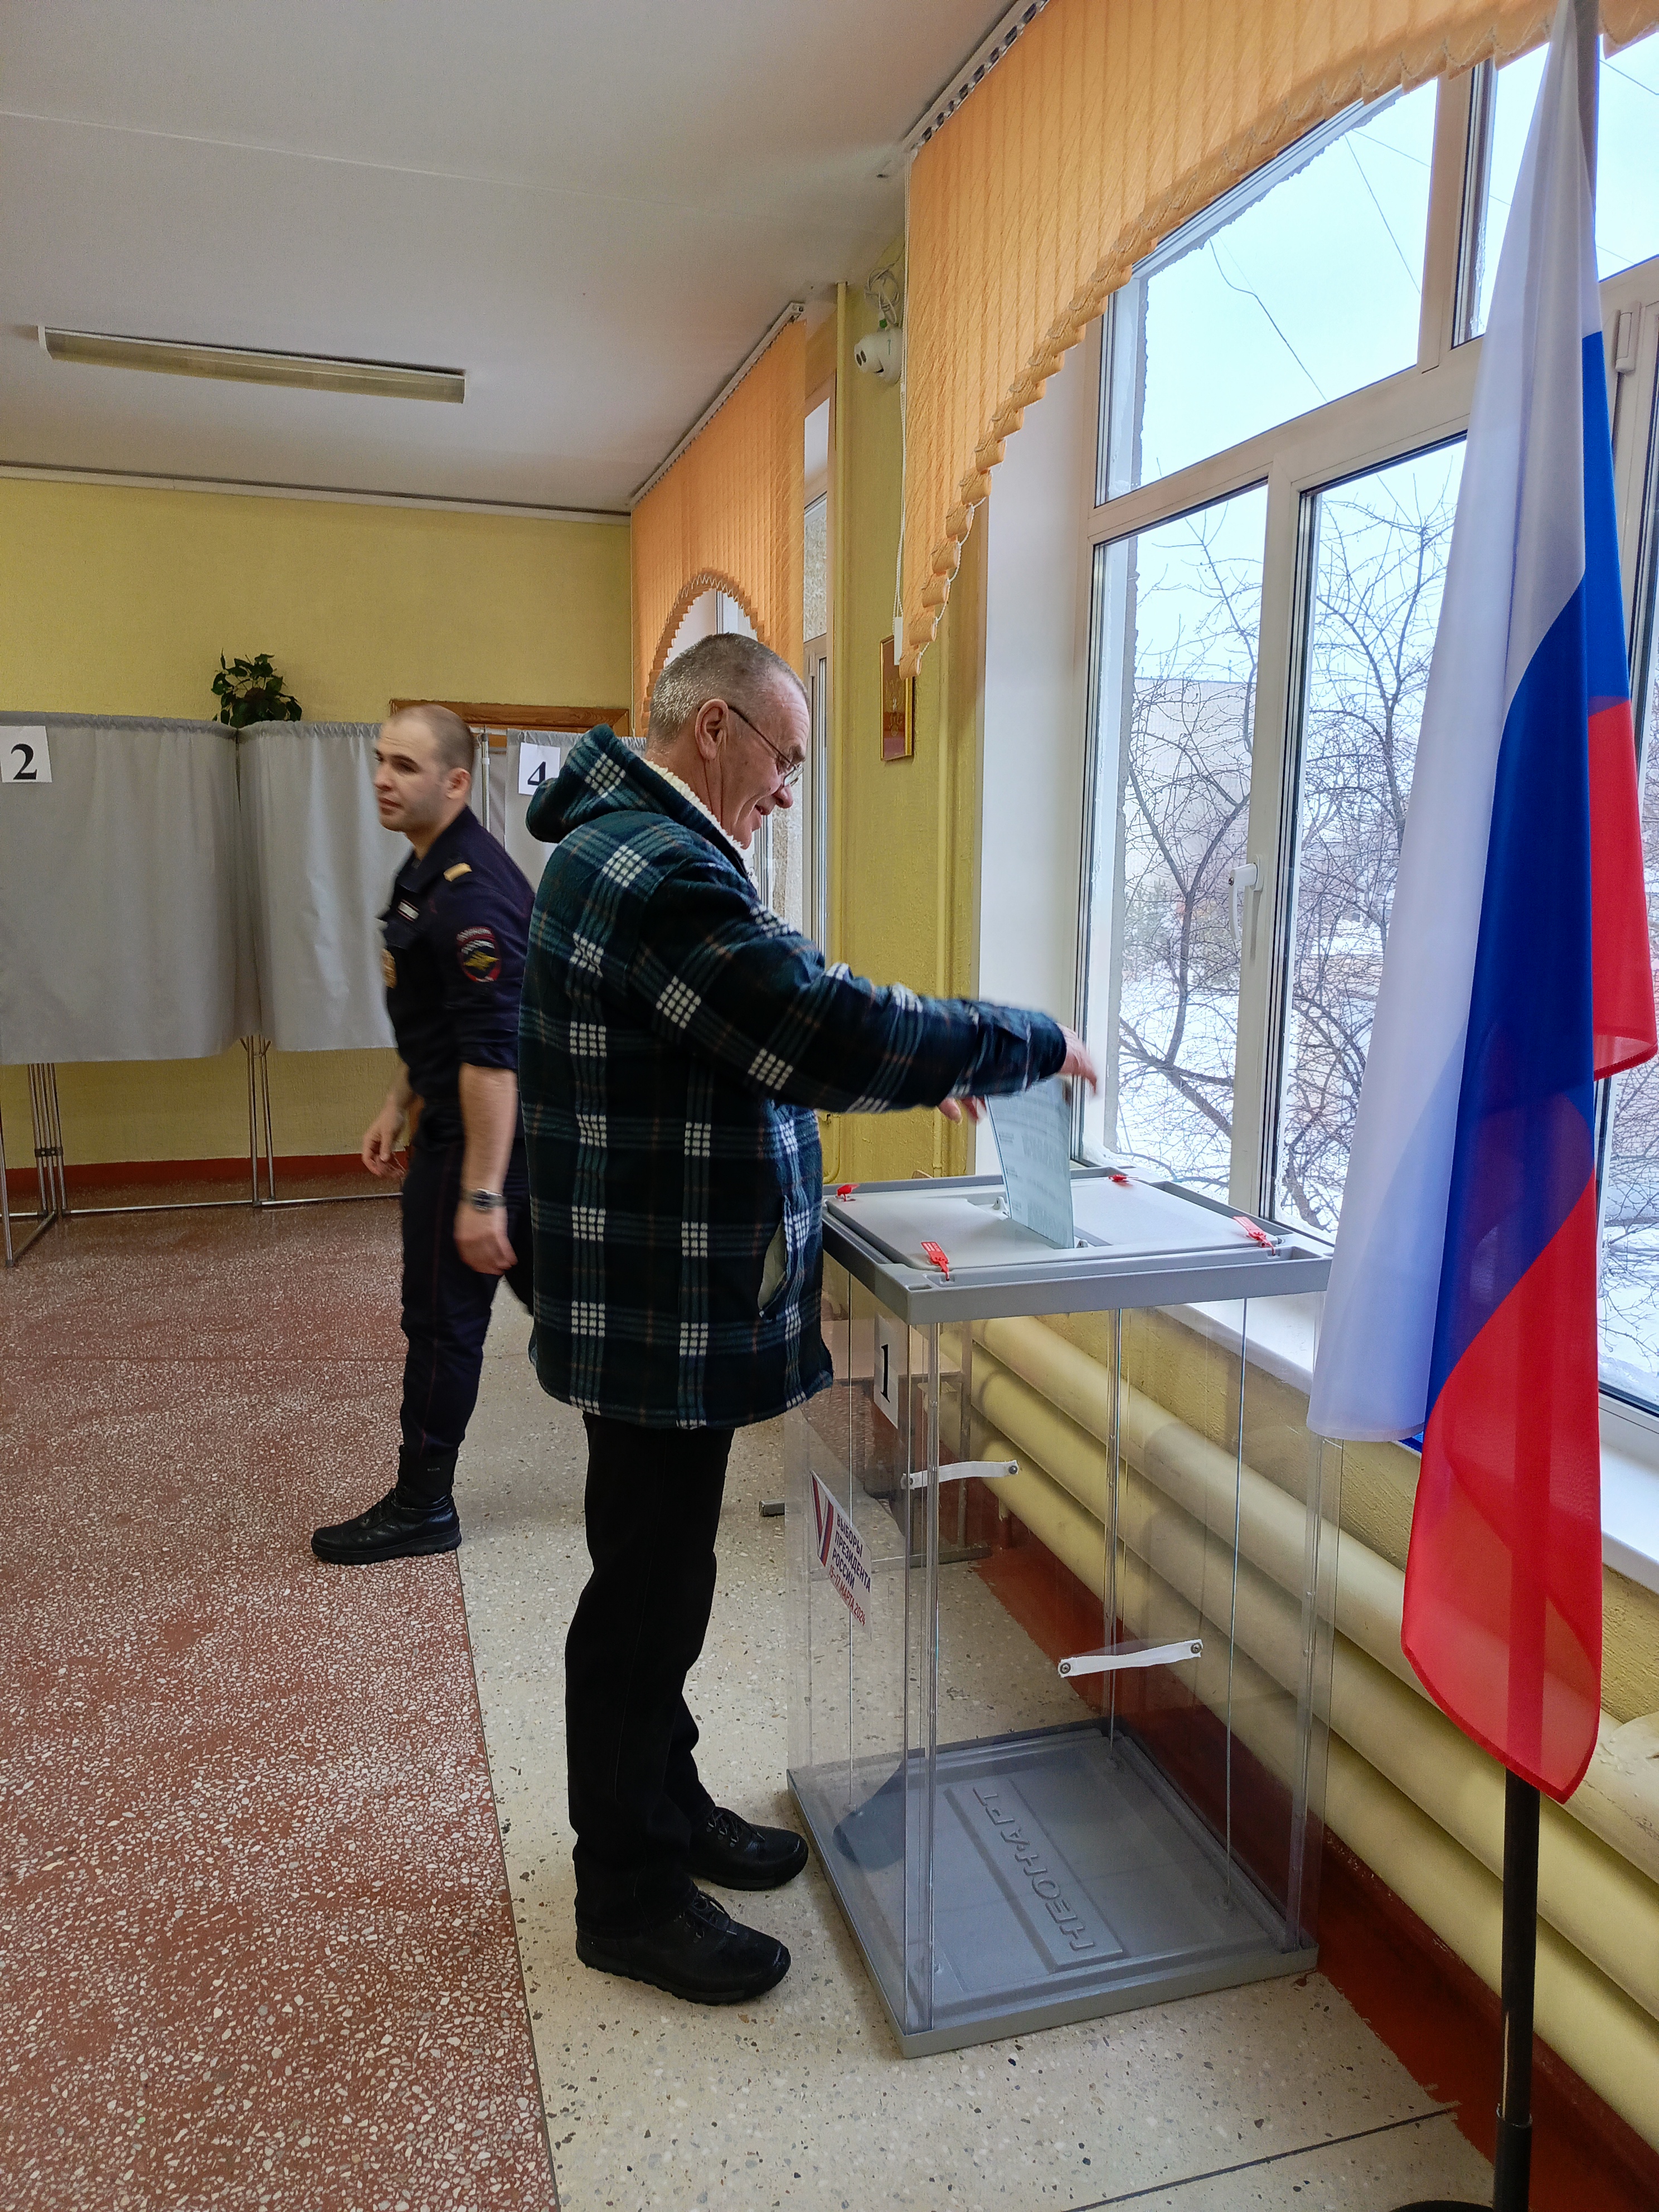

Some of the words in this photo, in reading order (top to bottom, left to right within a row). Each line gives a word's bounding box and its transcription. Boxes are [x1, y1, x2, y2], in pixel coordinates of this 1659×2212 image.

[11, 743, 37, 780] 2
[527, 761, 546, 786] 4
[880, 1343, 890, 1403] 1
[837, 1512, 863, 1558] ВЫБОРЫ
[832, 1547, 855, 1590] РОССИИ
[835, 1530, 871, 1593] ПРЕЗИДЕНТА
[839, 1580, 855, 1611] МАРТА
[853, 1603, 866, 1627] 2024
